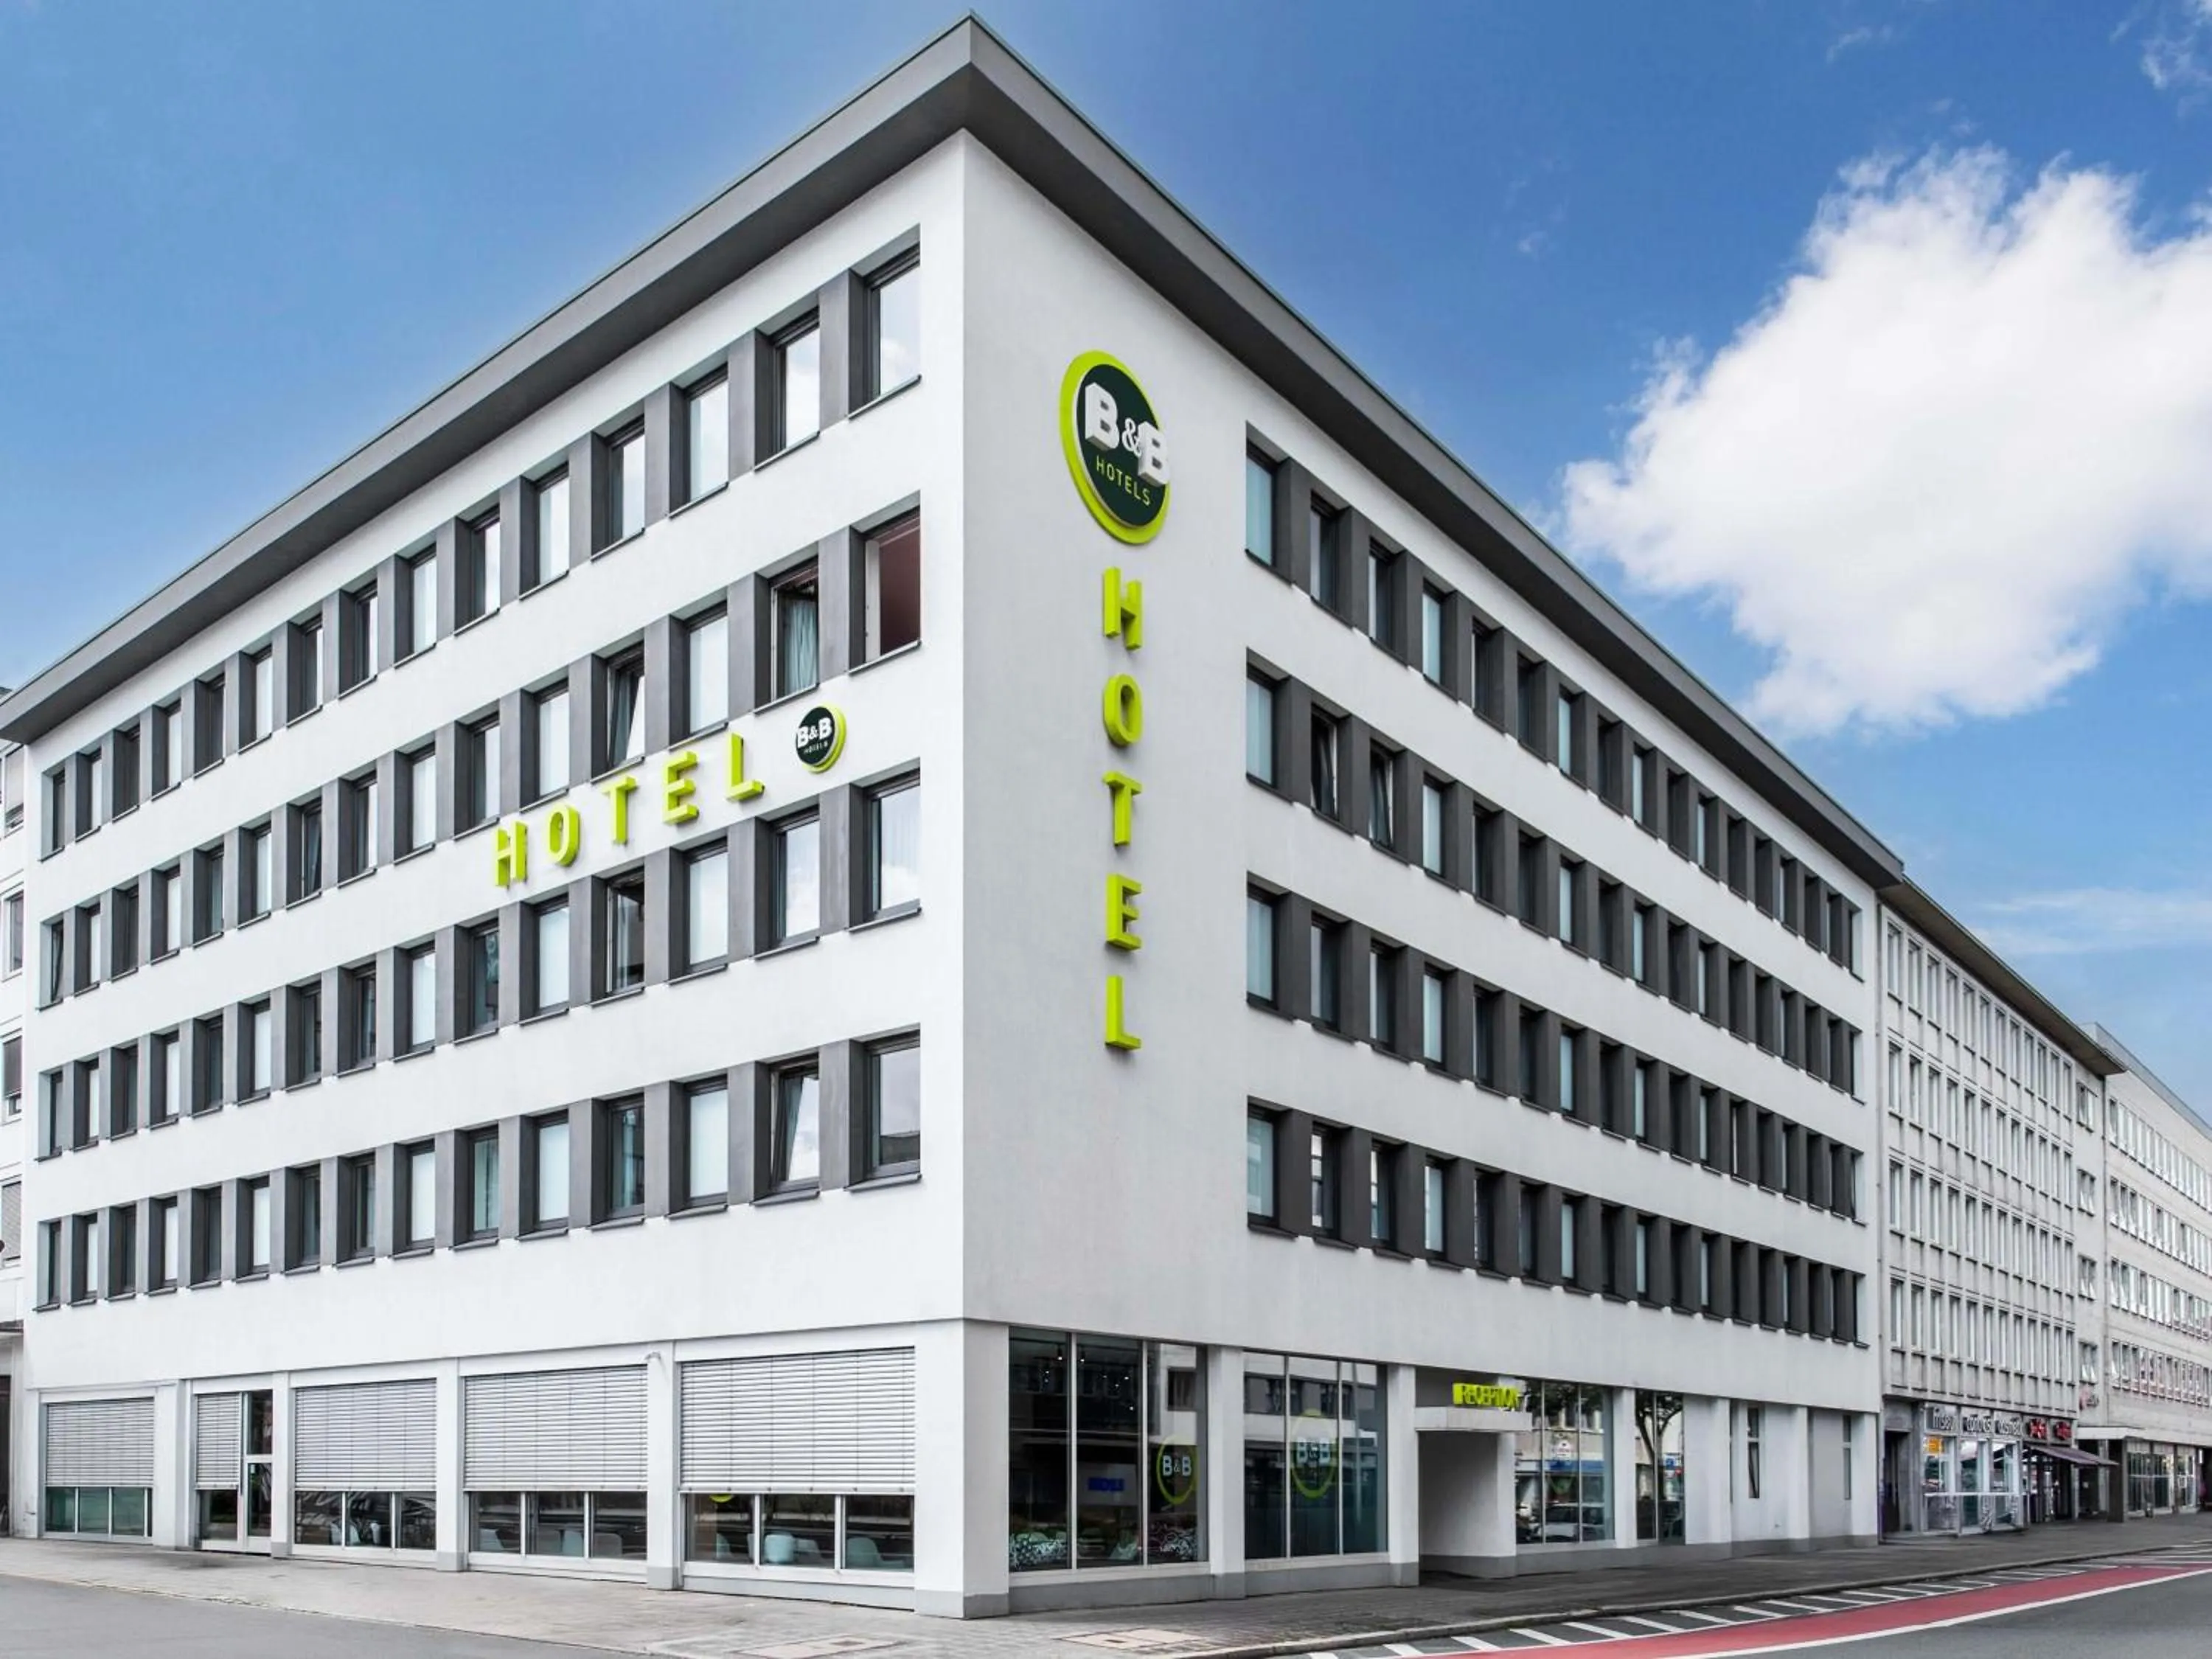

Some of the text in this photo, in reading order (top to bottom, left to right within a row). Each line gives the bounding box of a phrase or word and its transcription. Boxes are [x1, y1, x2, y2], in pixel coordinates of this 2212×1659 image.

[1085, 382, 1169, 487] B&B
[1096, 455, 1150, 506] HOTELS
[797, 717, 832, 748] B&B
[495, 732, 765, 888] HOTEL
[1102, 566, 1142, 1052] HOTEL
[1163, 1455, 1192, 1476] B&B
[1296, 1437, 1330, 1466] B&B
